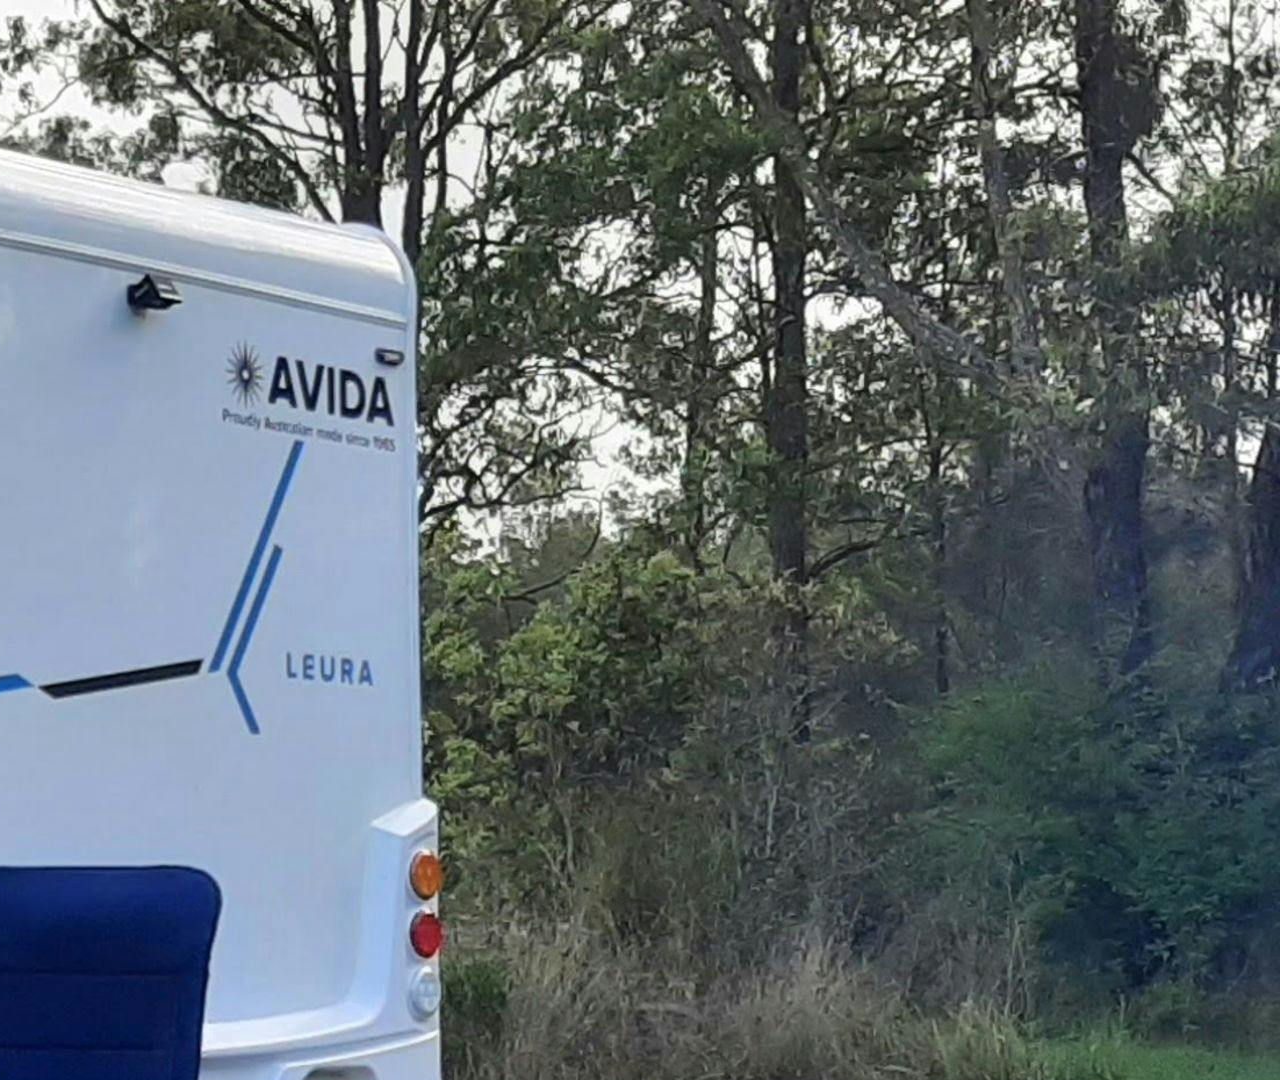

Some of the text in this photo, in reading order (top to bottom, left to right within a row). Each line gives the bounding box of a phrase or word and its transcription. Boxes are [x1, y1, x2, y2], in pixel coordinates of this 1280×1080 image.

[268, 356, 395, 427] AVIDA
[222, 408, 261, 431] Proudly
[286, 651, 374, 687] LEURA
